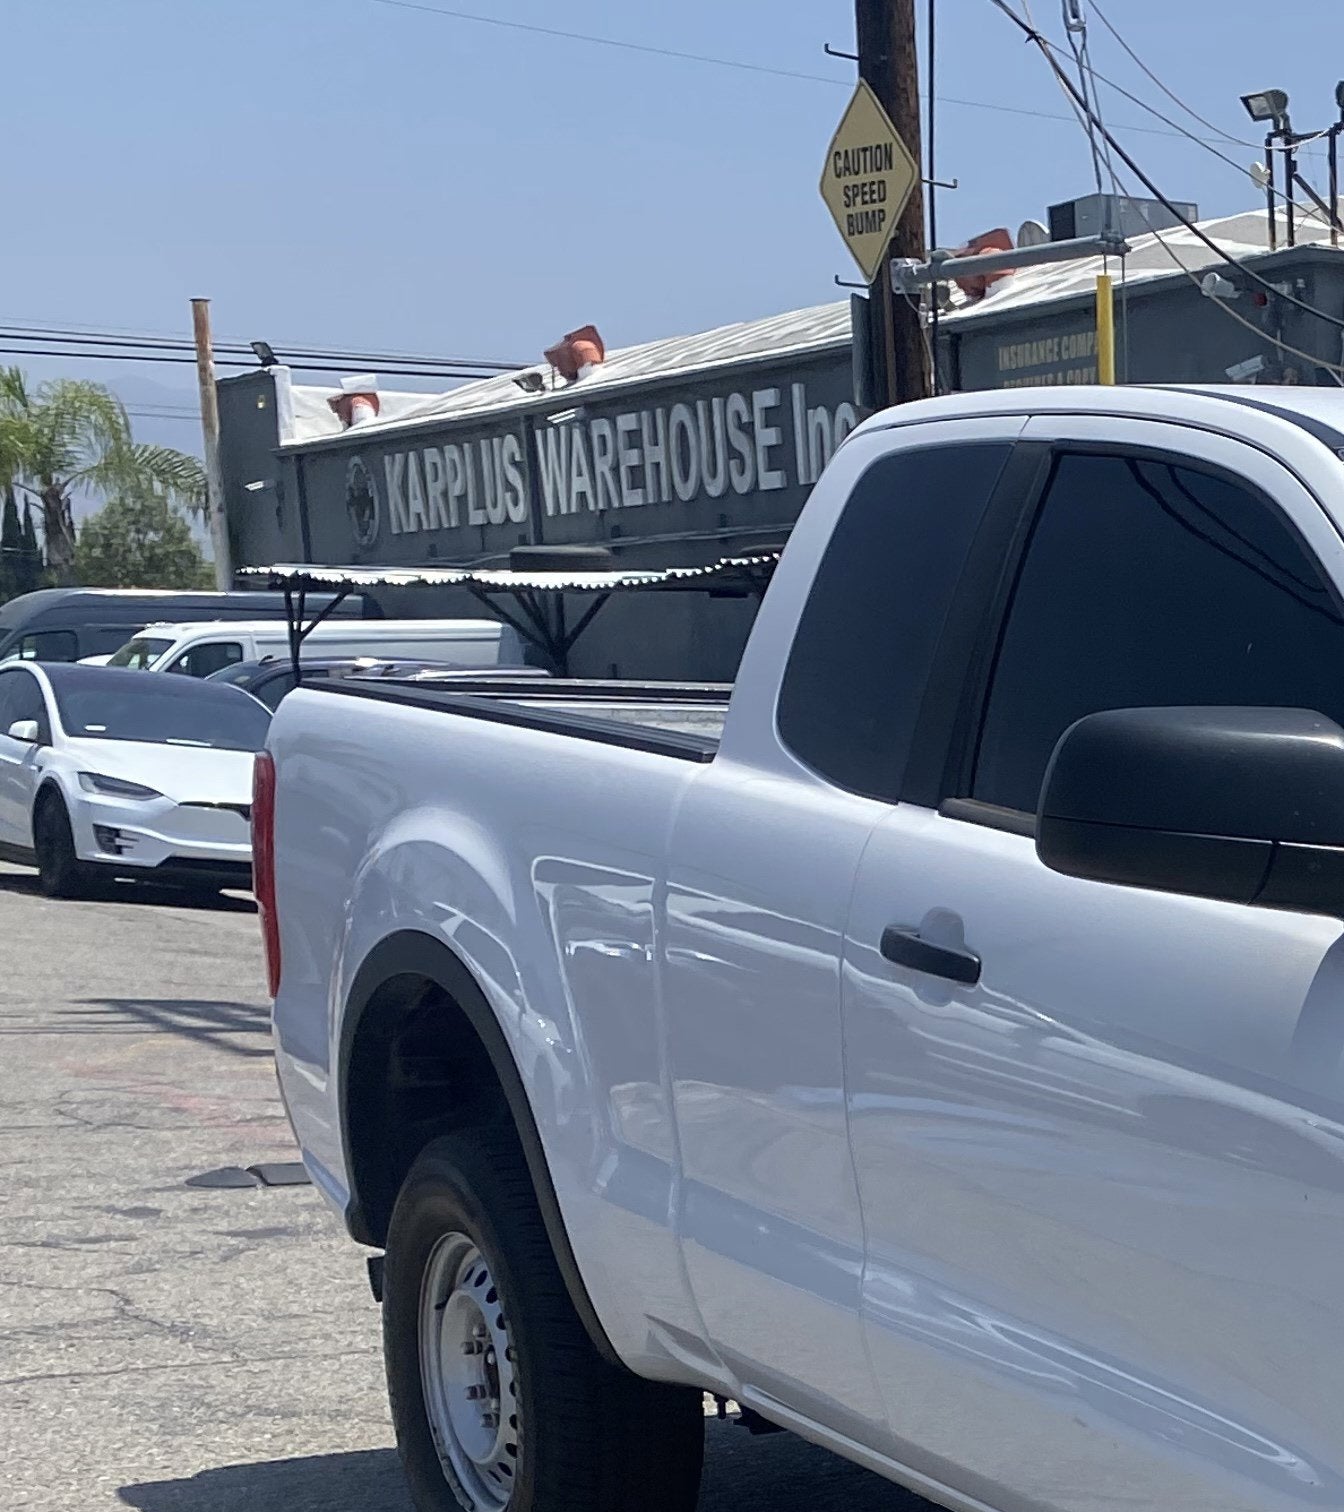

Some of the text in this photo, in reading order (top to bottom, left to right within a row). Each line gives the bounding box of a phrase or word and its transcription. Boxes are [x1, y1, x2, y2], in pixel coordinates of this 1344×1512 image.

[833, 142, 893, 178] CAUTION
[843, 180, 886, 208] SPEED
[846, 209, 886, 236] BUMP
[999, 331, 1098, 371] INSURANCE COMP
[384, 433, 528, 534] KARPLUS
[535, 387, 787, 516] WAREHOUSE
